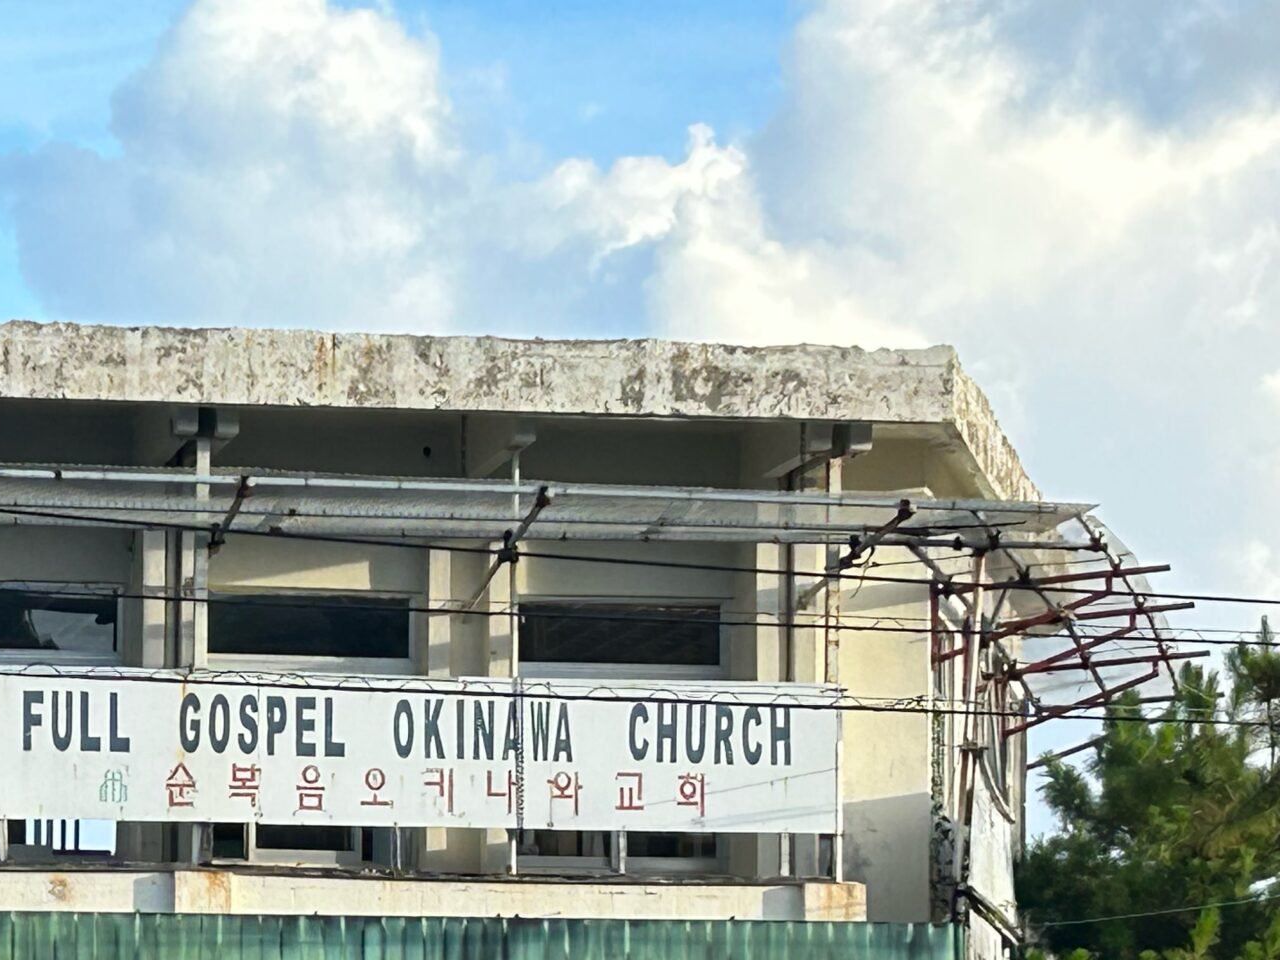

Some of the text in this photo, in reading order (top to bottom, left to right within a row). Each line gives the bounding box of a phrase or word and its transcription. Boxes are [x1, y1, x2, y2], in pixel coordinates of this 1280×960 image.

[21, 690, 792, 766] FULL GOSPEL OKINAWA CHURCH
[165, 762, 705, 816] 순복음오키나와교회
